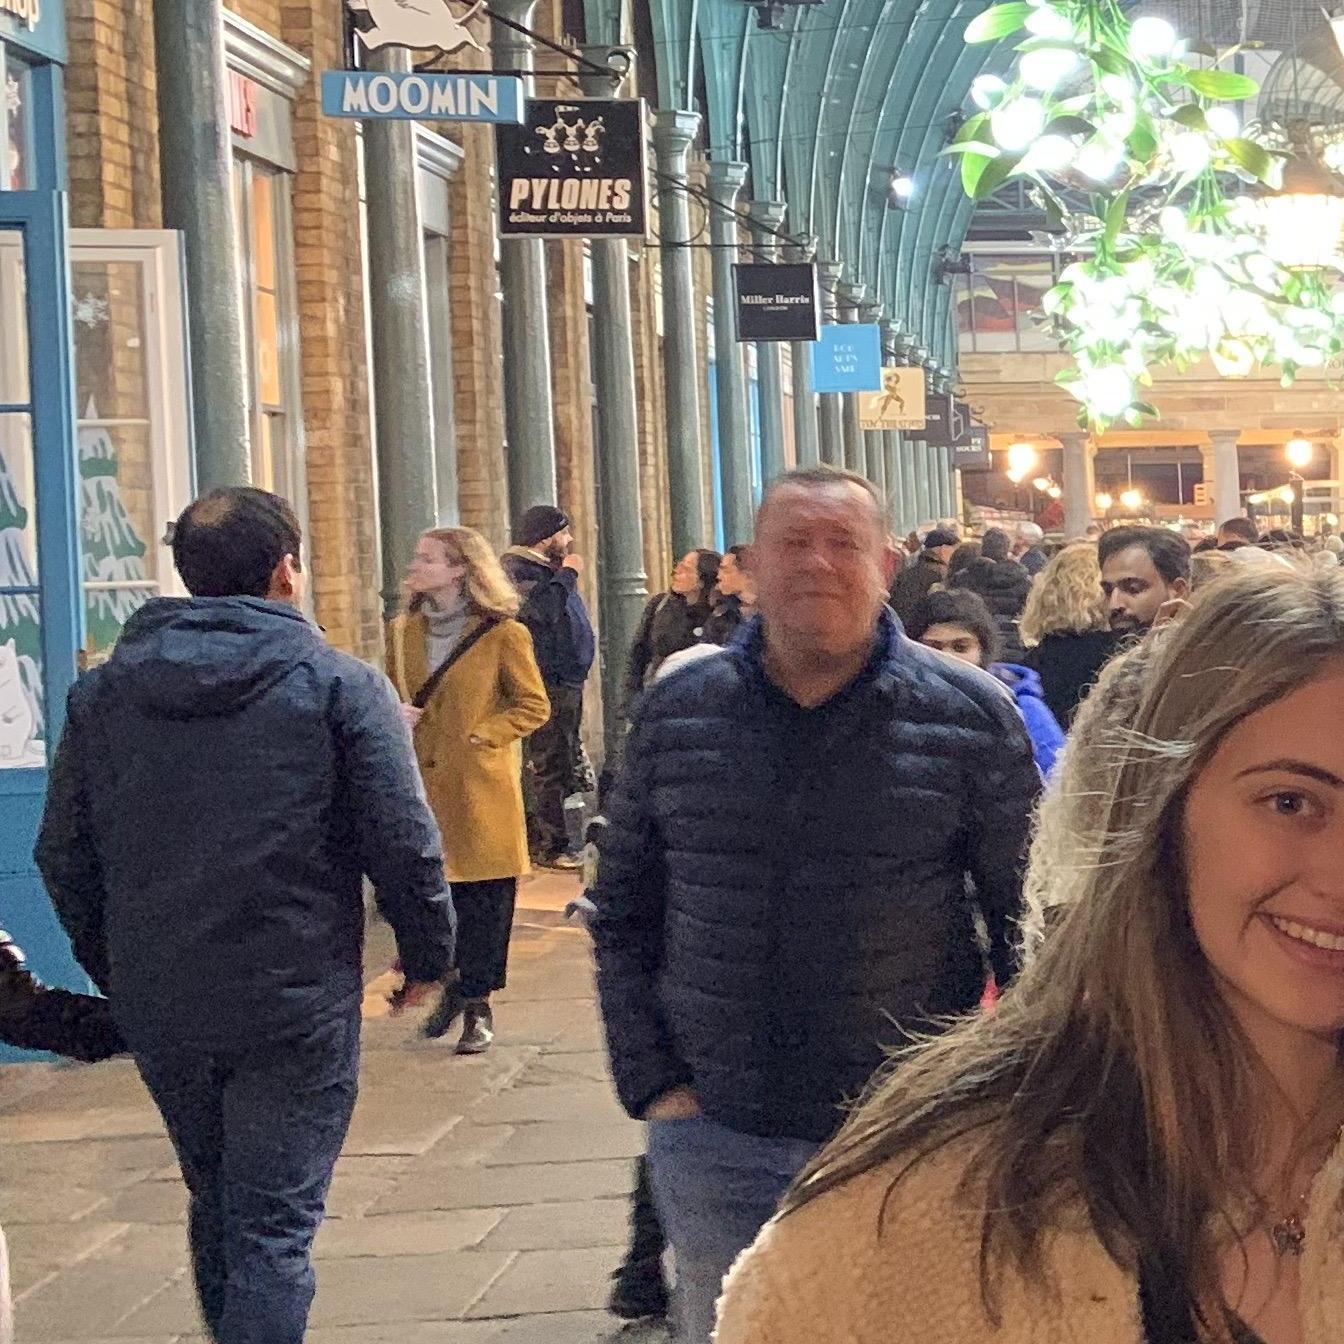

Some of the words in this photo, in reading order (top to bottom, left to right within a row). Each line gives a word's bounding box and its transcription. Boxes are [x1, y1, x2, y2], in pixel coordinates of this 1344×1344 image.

[342, 75, 499, 117] MOOMIN
[509, 177, 632, 210] PYLONES
[605, 212, 632, 223] Paris
[740, 294, 774, 305] Miller
[775, 294, 810, 305] Harris
